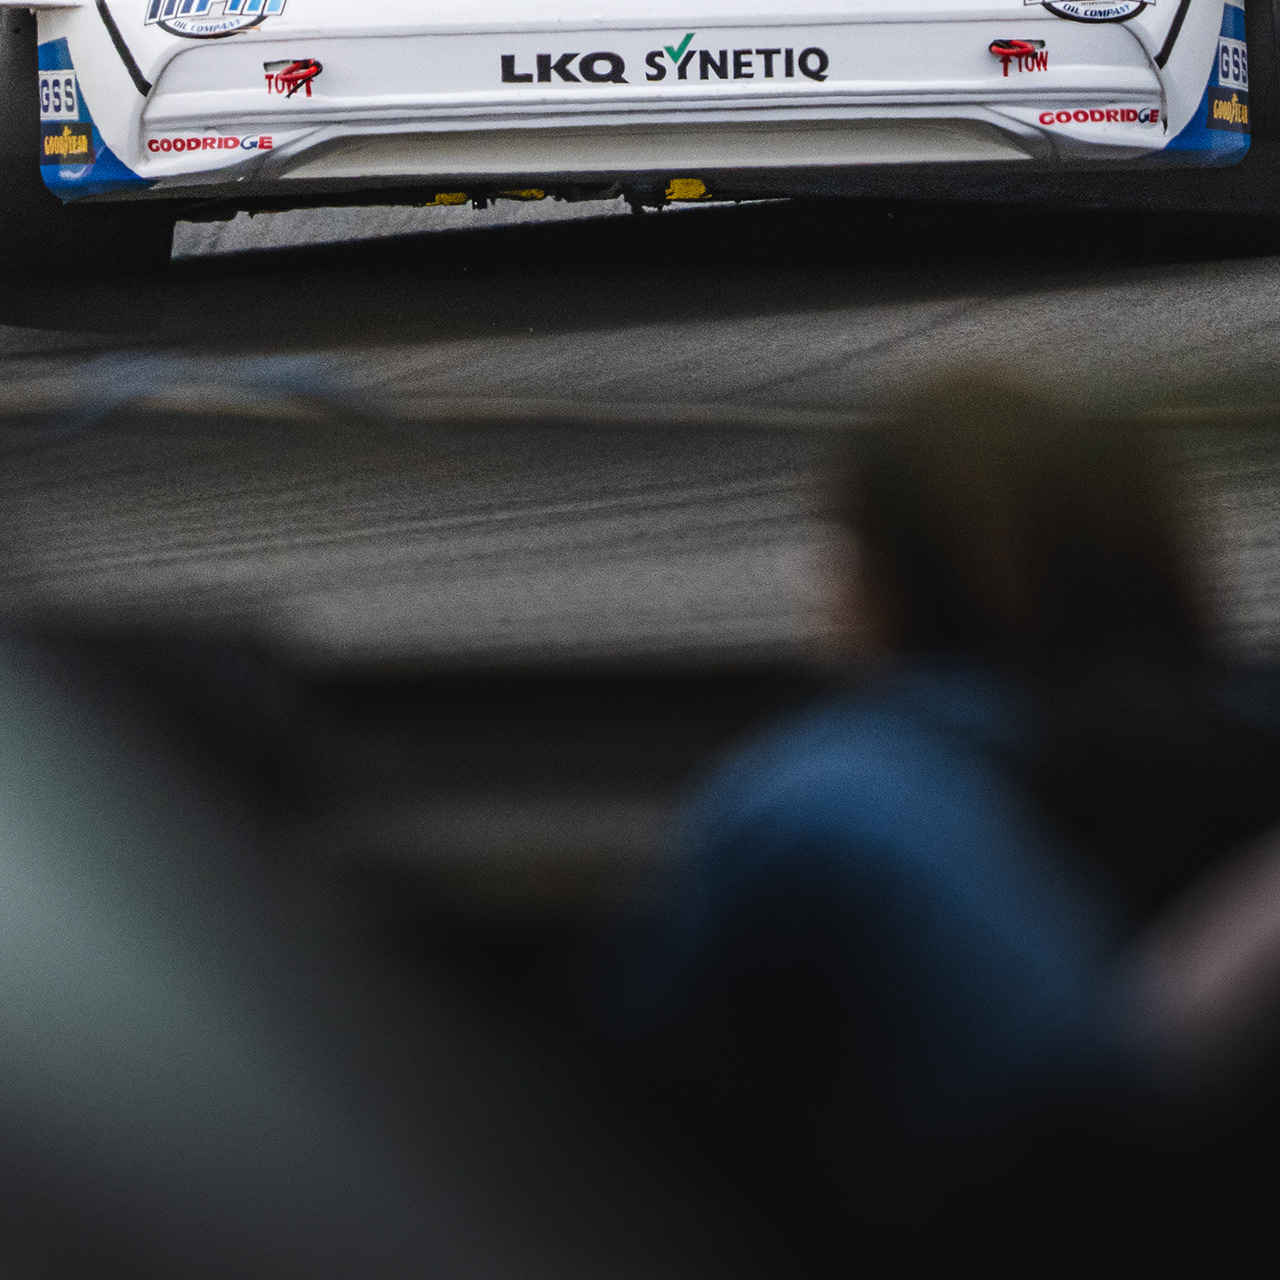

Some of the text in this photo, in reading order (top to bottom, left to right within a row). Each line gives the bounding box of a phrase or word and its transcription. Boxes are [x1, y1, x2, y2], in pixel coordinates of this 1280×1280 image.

[1063, 2, 1130, 18] OIL COMPANY
[173, 19, 188, 31] OIL
[191, 18, 242, 33] COMPANY
[501, 34, 829, 84] LKQ SYNETIQ
[1220, 44, 1247, 84] GSS
[40, 78, 75, 113] GSS
[1038, 107, 1160, 125] GOODRIDGE
[147, 135, 273, 153] GOODRIDGE
